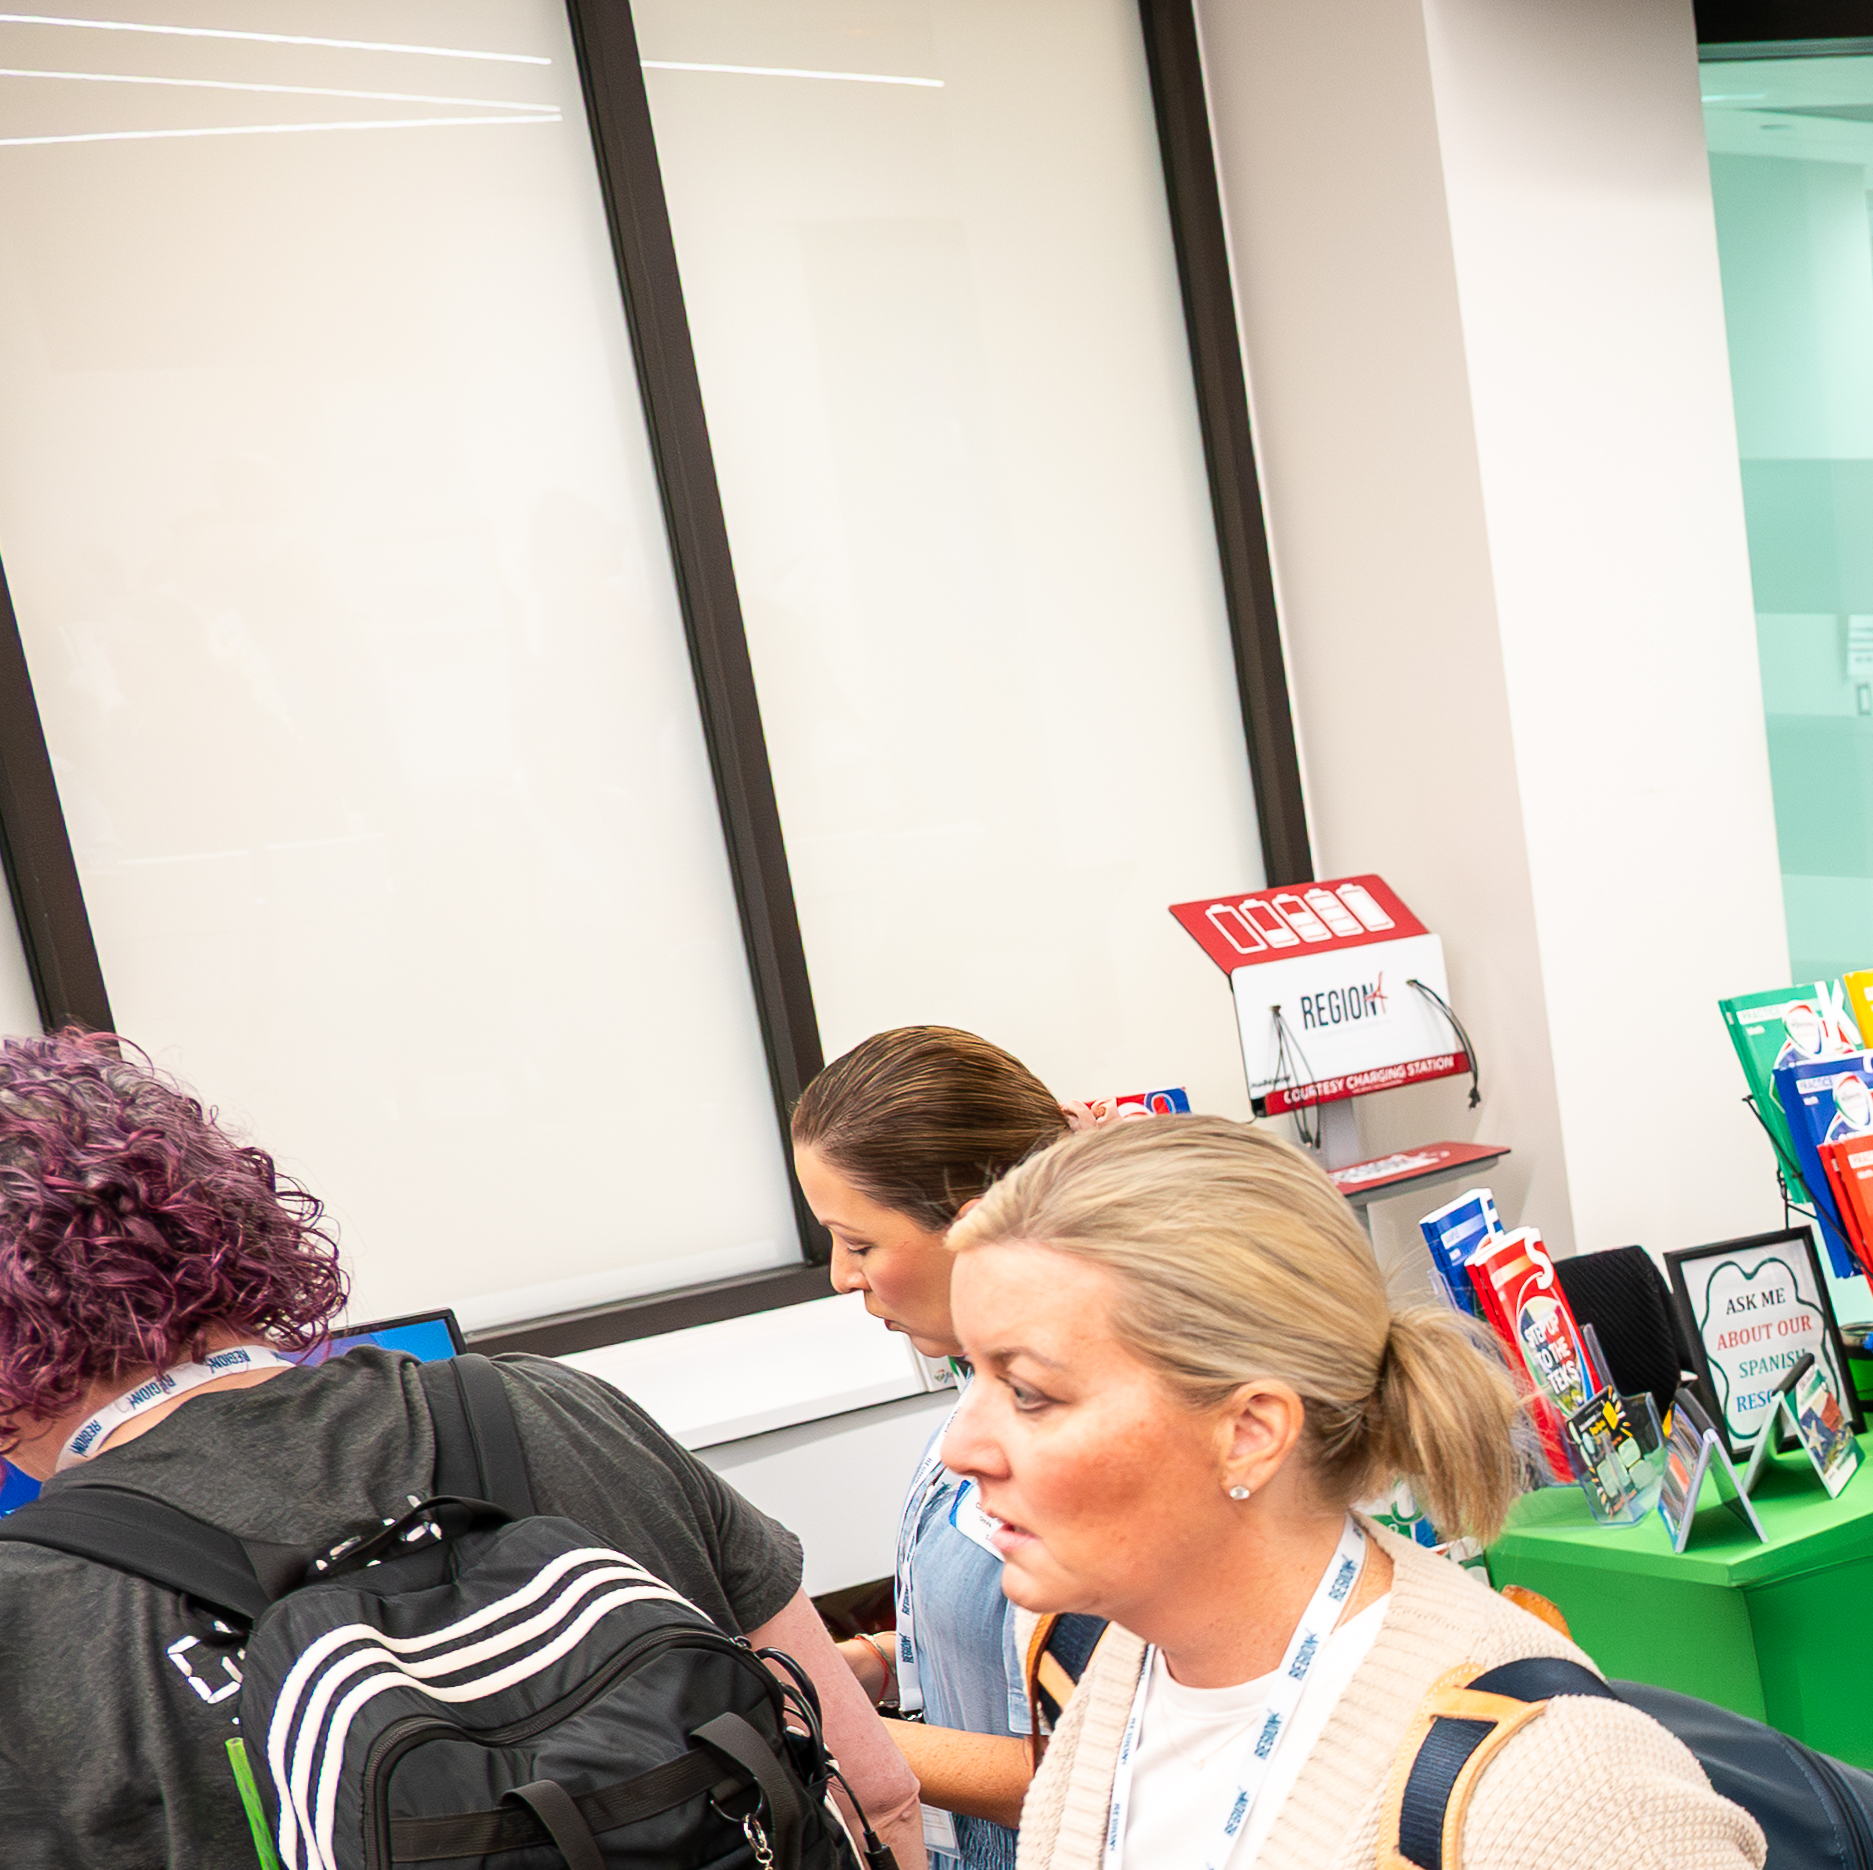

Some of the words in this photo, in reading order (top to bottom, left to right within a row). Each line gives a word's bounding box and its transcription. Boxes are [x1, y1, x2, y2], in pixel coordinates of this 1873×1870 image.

[1345, 1064, 1406, 1092] CHARGING
[1406, 1054, 1456, 1078] STATION
[1725, 1292, 1758, 1317] ASK
[1761, 1287, 1788, 1310] ME
[1523, 1317, 1546, 1349] STEP
[1542, 1311, 1560, 1339] UP
[1716, 1321, 1774, 1352] ABOUT
[1777, 1314, 1813, 1338] OUR
[1535, 1346, 1553, 1369] TO
[1548, 1334, 1572, 1362] THE
[1546, 1358, 1581, 1397] TEKS
